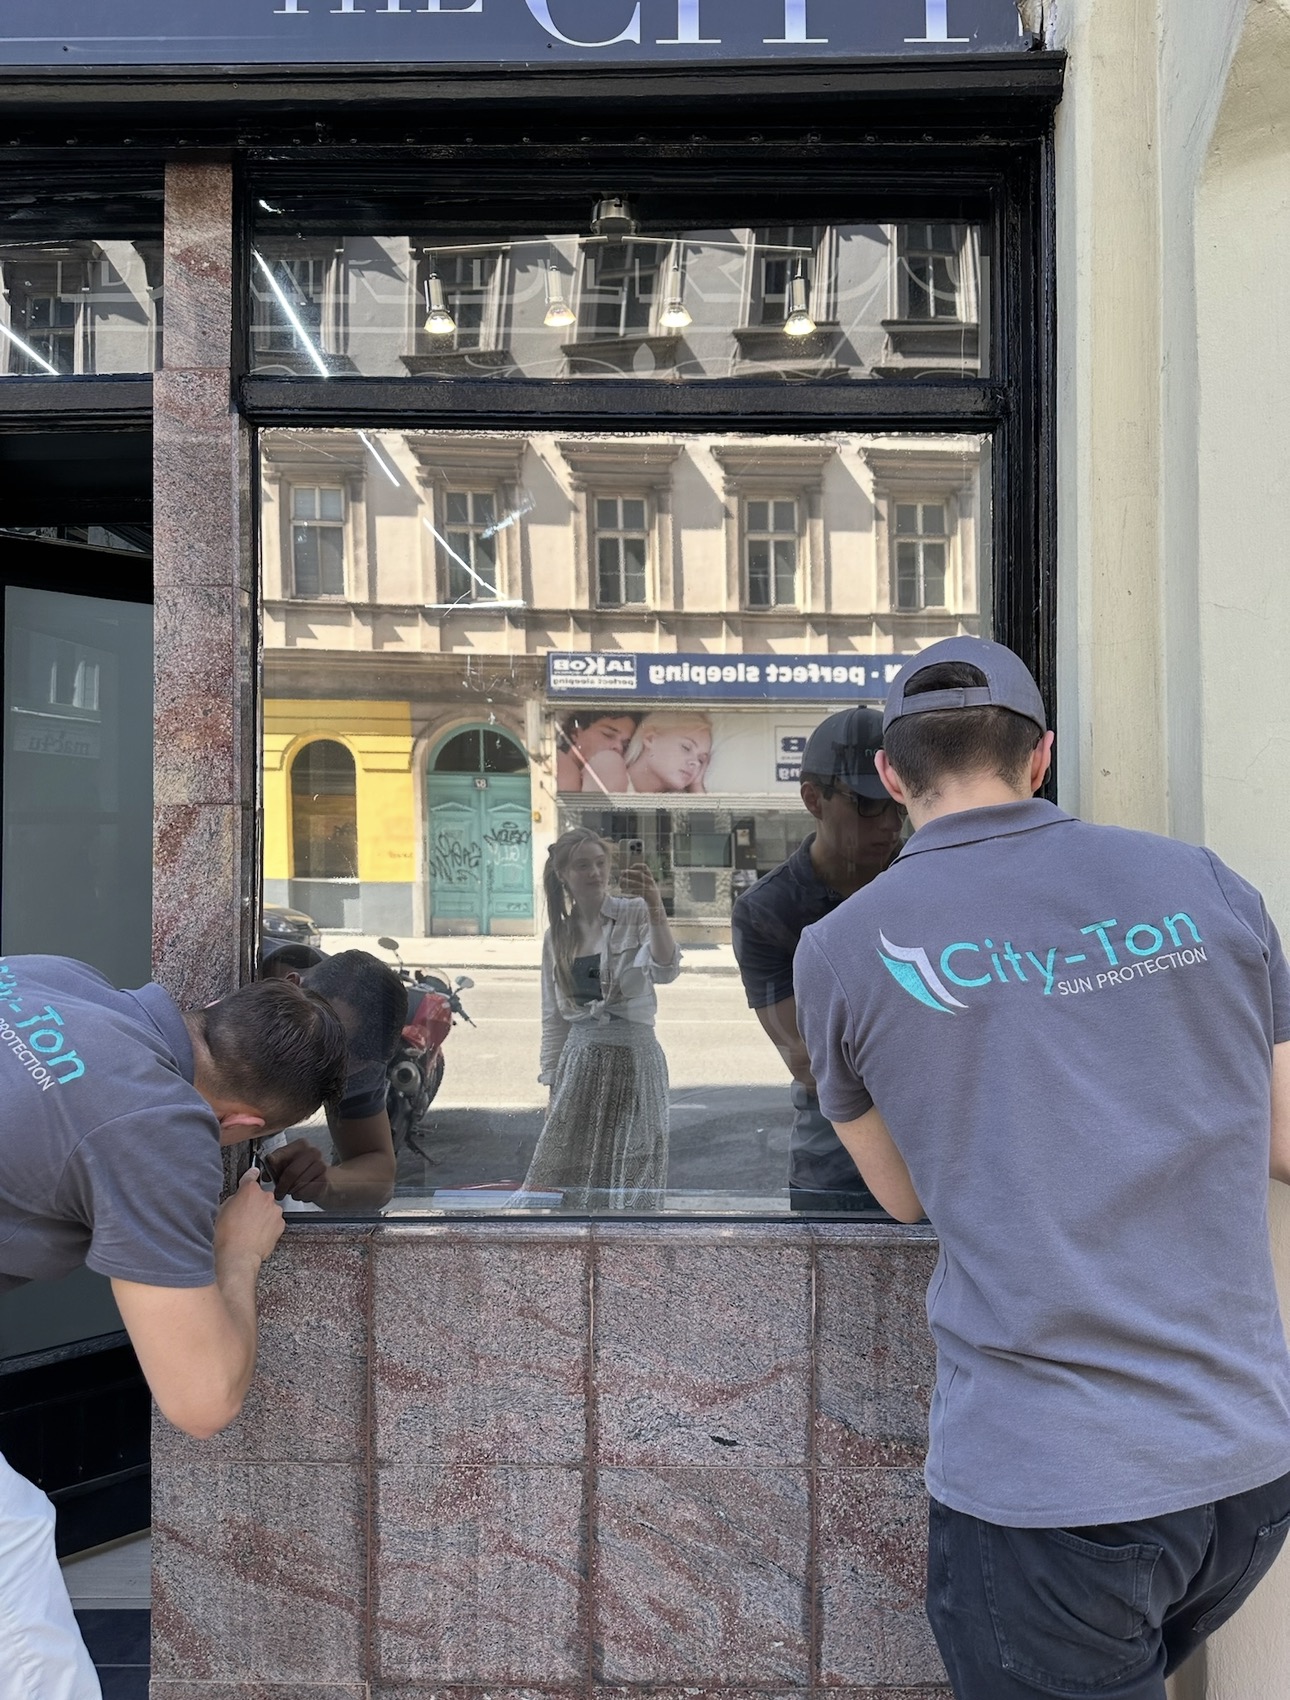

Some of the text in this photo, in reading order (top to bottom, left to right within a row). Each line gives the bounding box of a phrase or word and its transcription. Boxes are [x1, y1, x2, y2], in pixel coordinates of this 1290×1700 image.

[940, 911, 1203, 995] City-Ton
[1058, 946, 1208, 996] SUN PROTECTION
